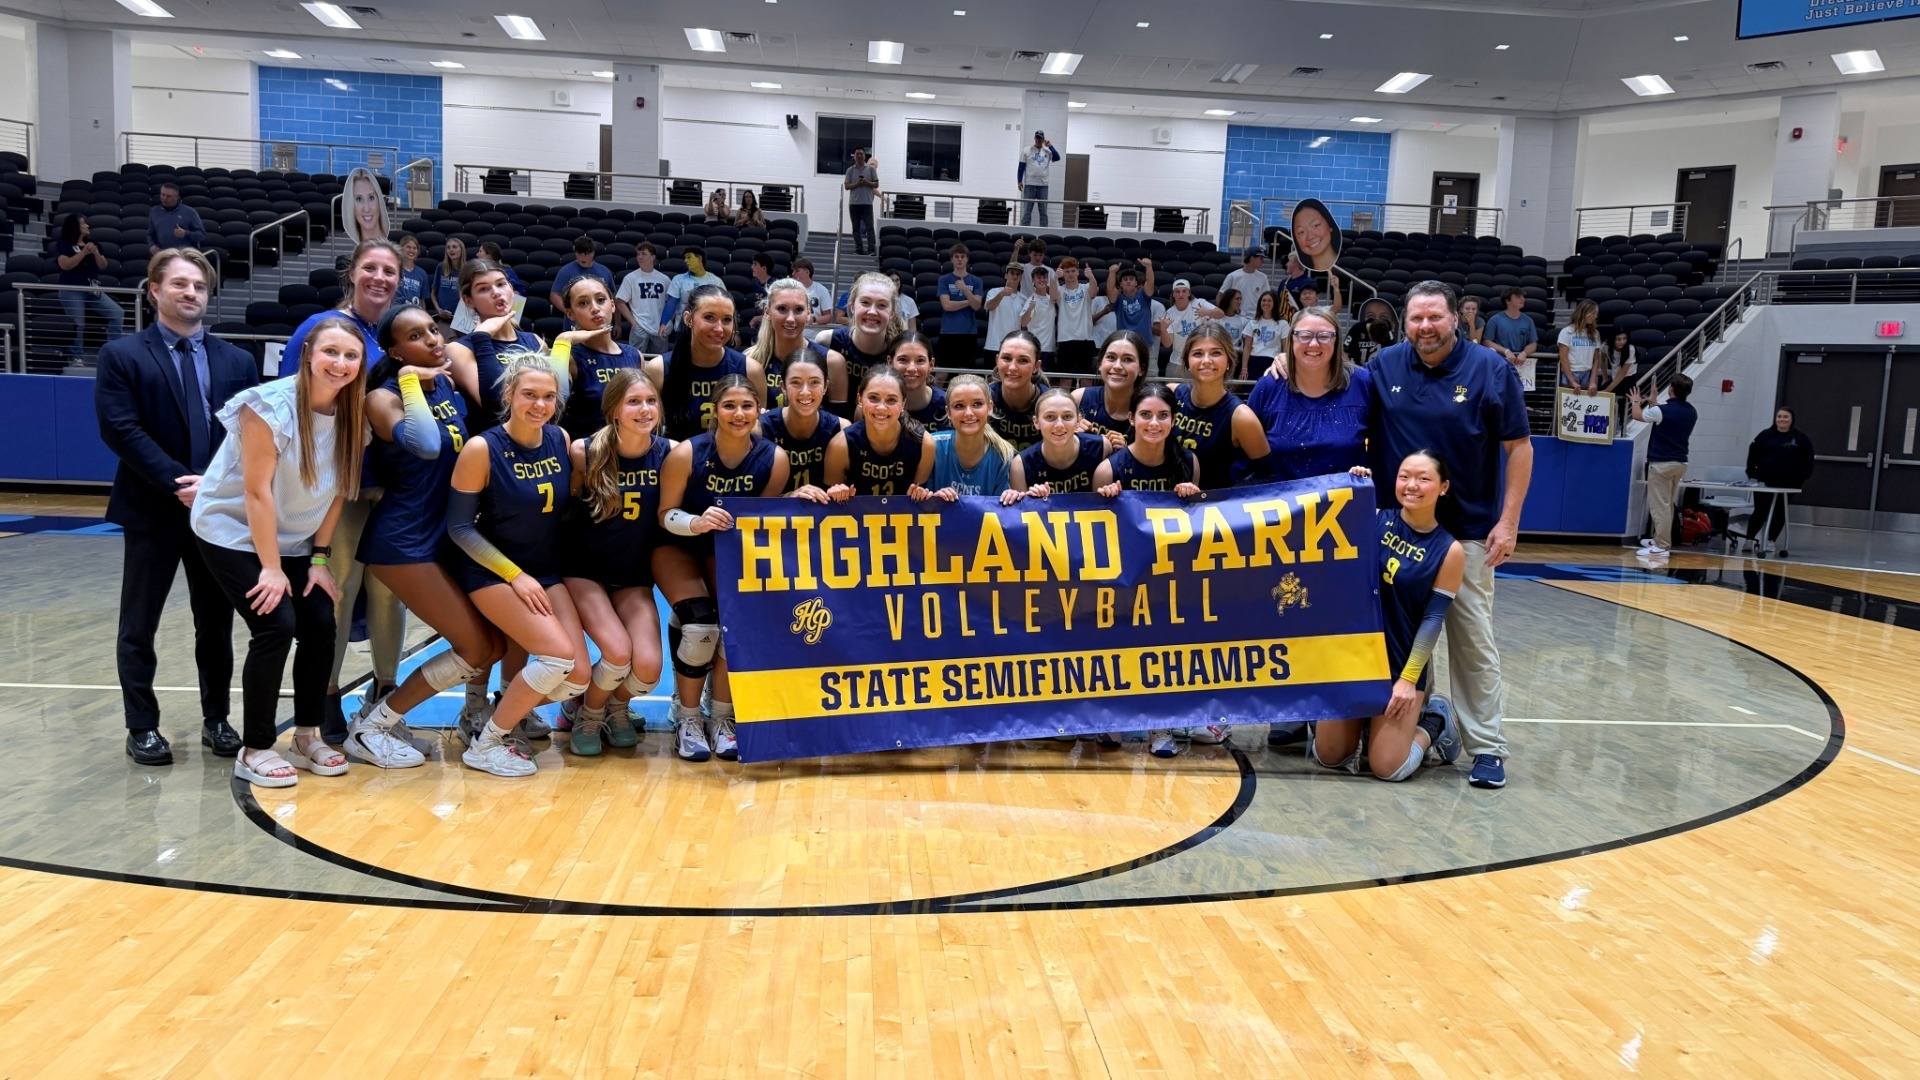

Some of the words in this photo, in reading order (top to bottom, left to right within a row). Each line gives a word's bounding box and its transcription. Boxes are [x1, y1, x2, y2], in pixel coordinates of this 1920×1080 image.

[1805, 7, 1839, 20] Just
[1844, 0, 1904, 15] Believe
[446, 424, 463, 453] 6
[1175, 412, 1213, 437] SCOTS
[514, 457, 562, 480] SCOTS
[862, 461, 904, 480] SCOTS
[1048, 470, 1089, 494] SCOTS
[537, 482, 554, 513] 7
[706, 474, 754, 494] SCOTS
[622, 491, 641, 521] 5
[736, 510, 1122, 592] HIGHLAND
[1145, 487, 1359, 576] PARK
[1380, 531, 1426, 563] SCOTS
[1382, 557, 1400, 584] 9
[790, 597, 833, 644] HP
[885, 578, 1218, 641] VOLLEYBALL
[820, 666, 932, 711] STATE
[942, 654, 1131, 702] SEMIFINAL
[1139, 643, 1291, 689] CHAMPS
